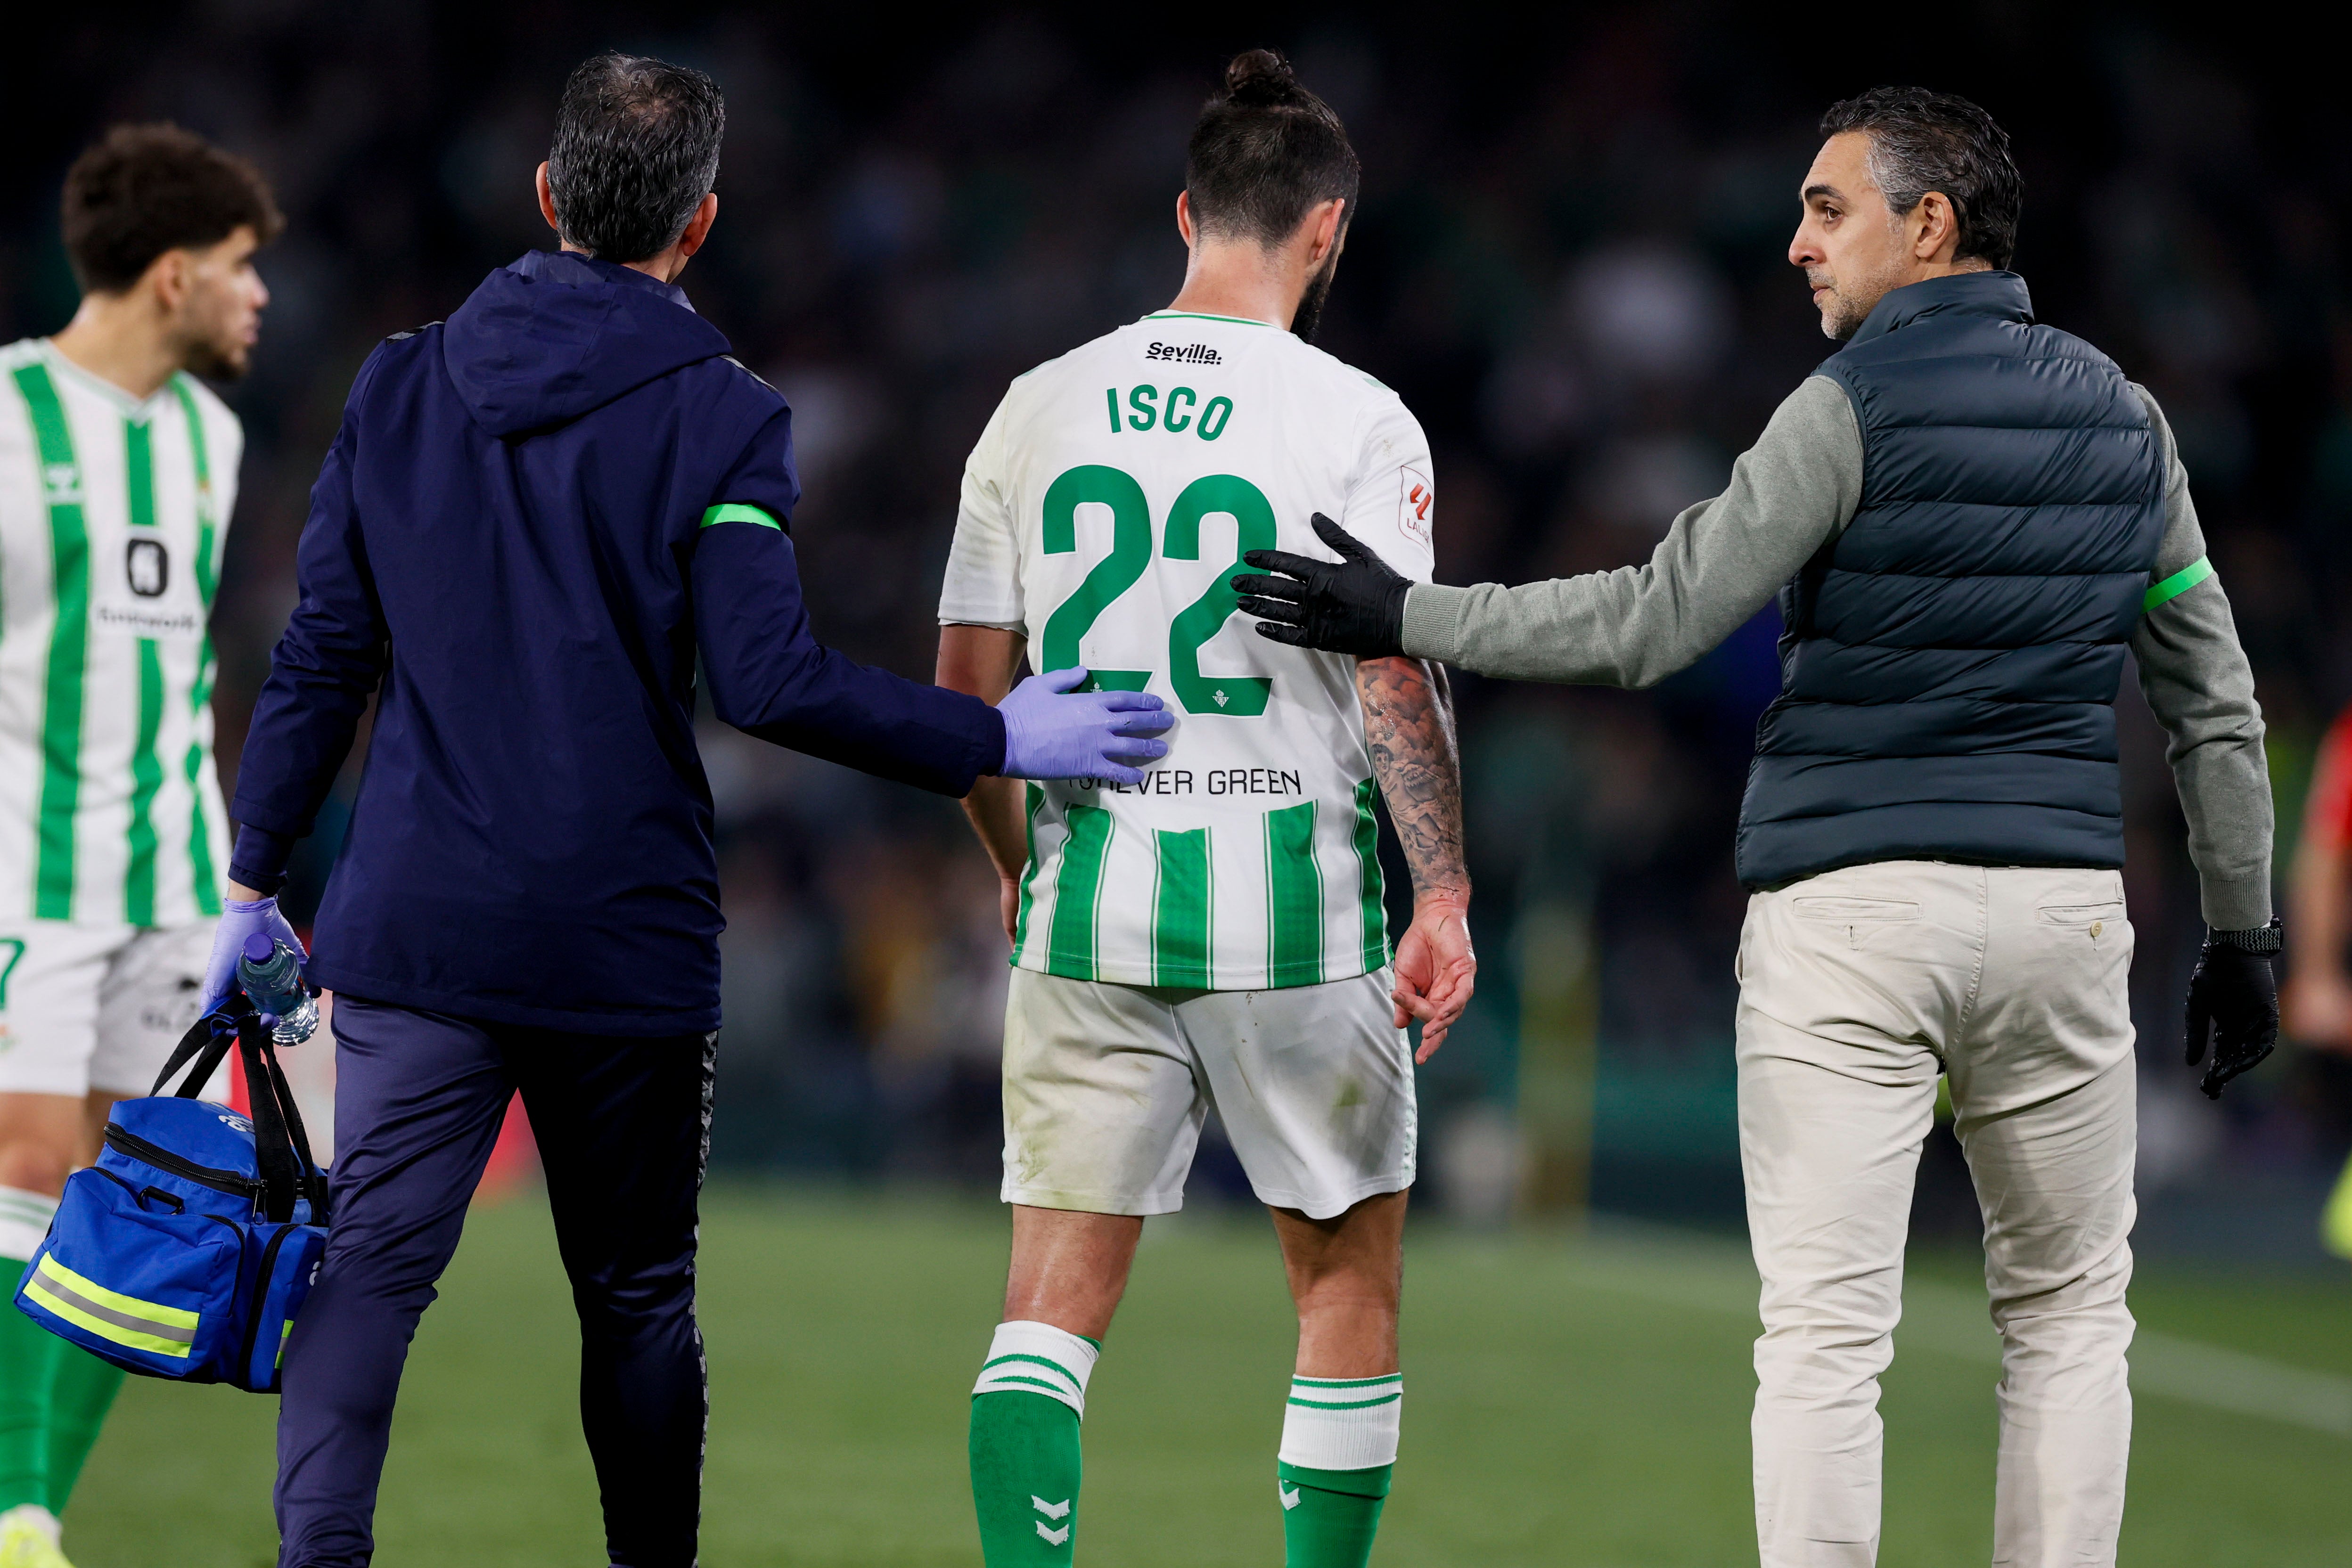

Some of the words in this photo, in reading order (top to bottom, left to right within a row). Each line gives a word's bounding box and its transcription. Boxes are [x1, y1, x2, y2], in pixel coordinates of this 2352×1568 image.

[1106, 384, 1233, 441] ISCO
[1042, 464, 1277, 717] 22
[1208, 768, 1302, 795] GREEN
